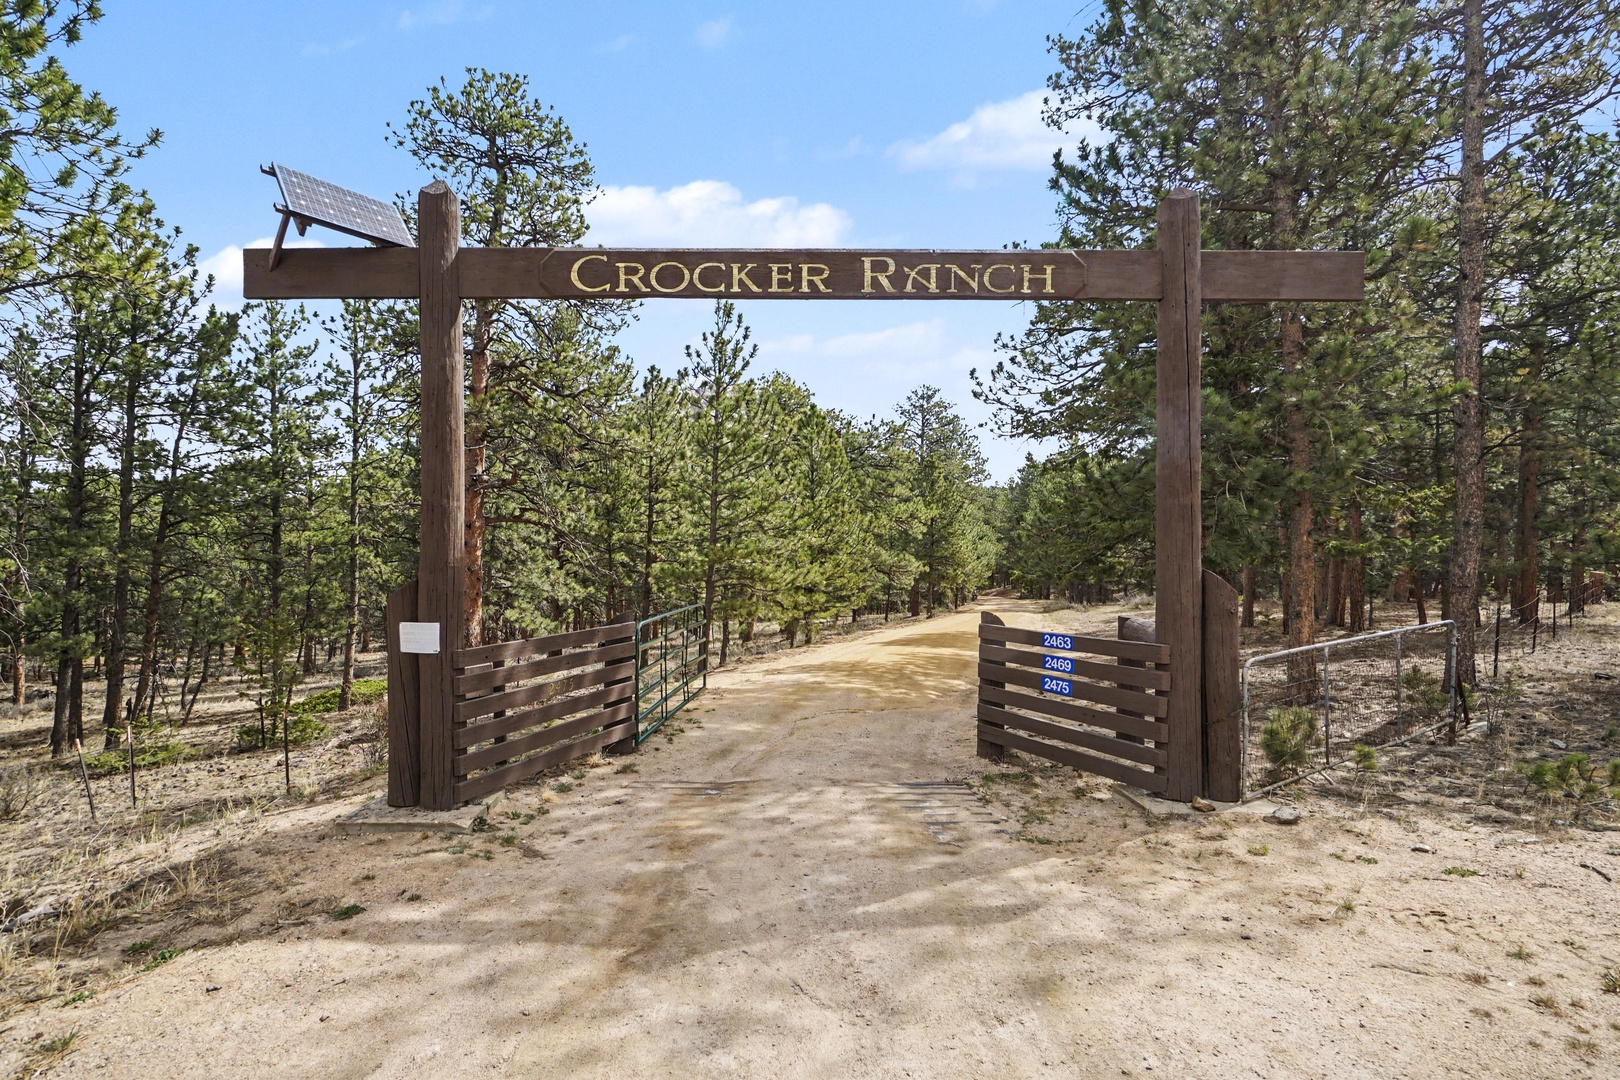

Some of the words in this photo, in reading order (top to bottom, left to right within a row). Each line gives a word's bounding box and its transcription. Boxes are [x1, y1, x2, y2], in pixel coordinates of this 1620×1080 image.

[570, 254, 832, 293] CROCKER
[861, 256, 1056, 294] RANCH
[1044, 634, 1072, 649] 2463
[1045, 656, 1072, 672] 2469
[549, 678, 574, 696] 2475
[1044, 678, 1070, 694] 2475
